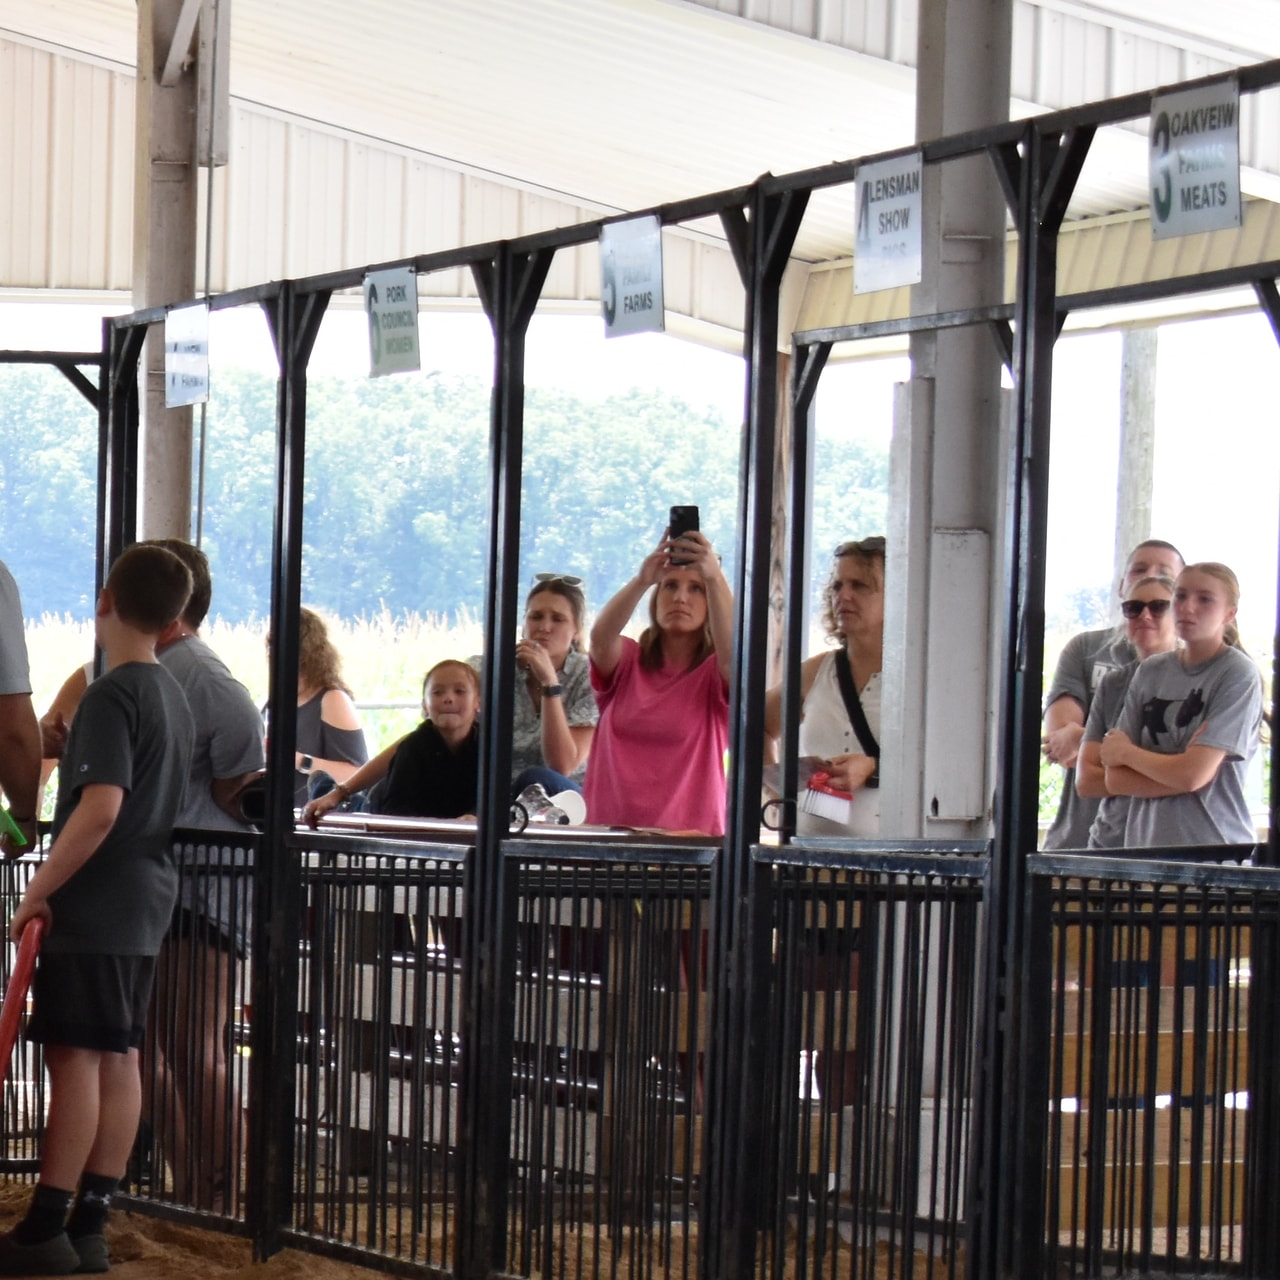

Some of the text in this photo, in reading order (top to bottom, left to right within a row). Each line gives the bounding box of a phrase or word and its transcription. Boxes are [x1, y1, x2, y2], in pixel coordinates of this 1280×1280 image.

[1171, 102, 1235, 138] OAKVEIW
[869, 171, 920, 203] LENSMAN
[1181, 181, 1227, 213] MEATS
[879, 208, 910, 235] SHOW
[386, 285, 408, 303] PORK
[624, 291, 652, 314] FARMS
